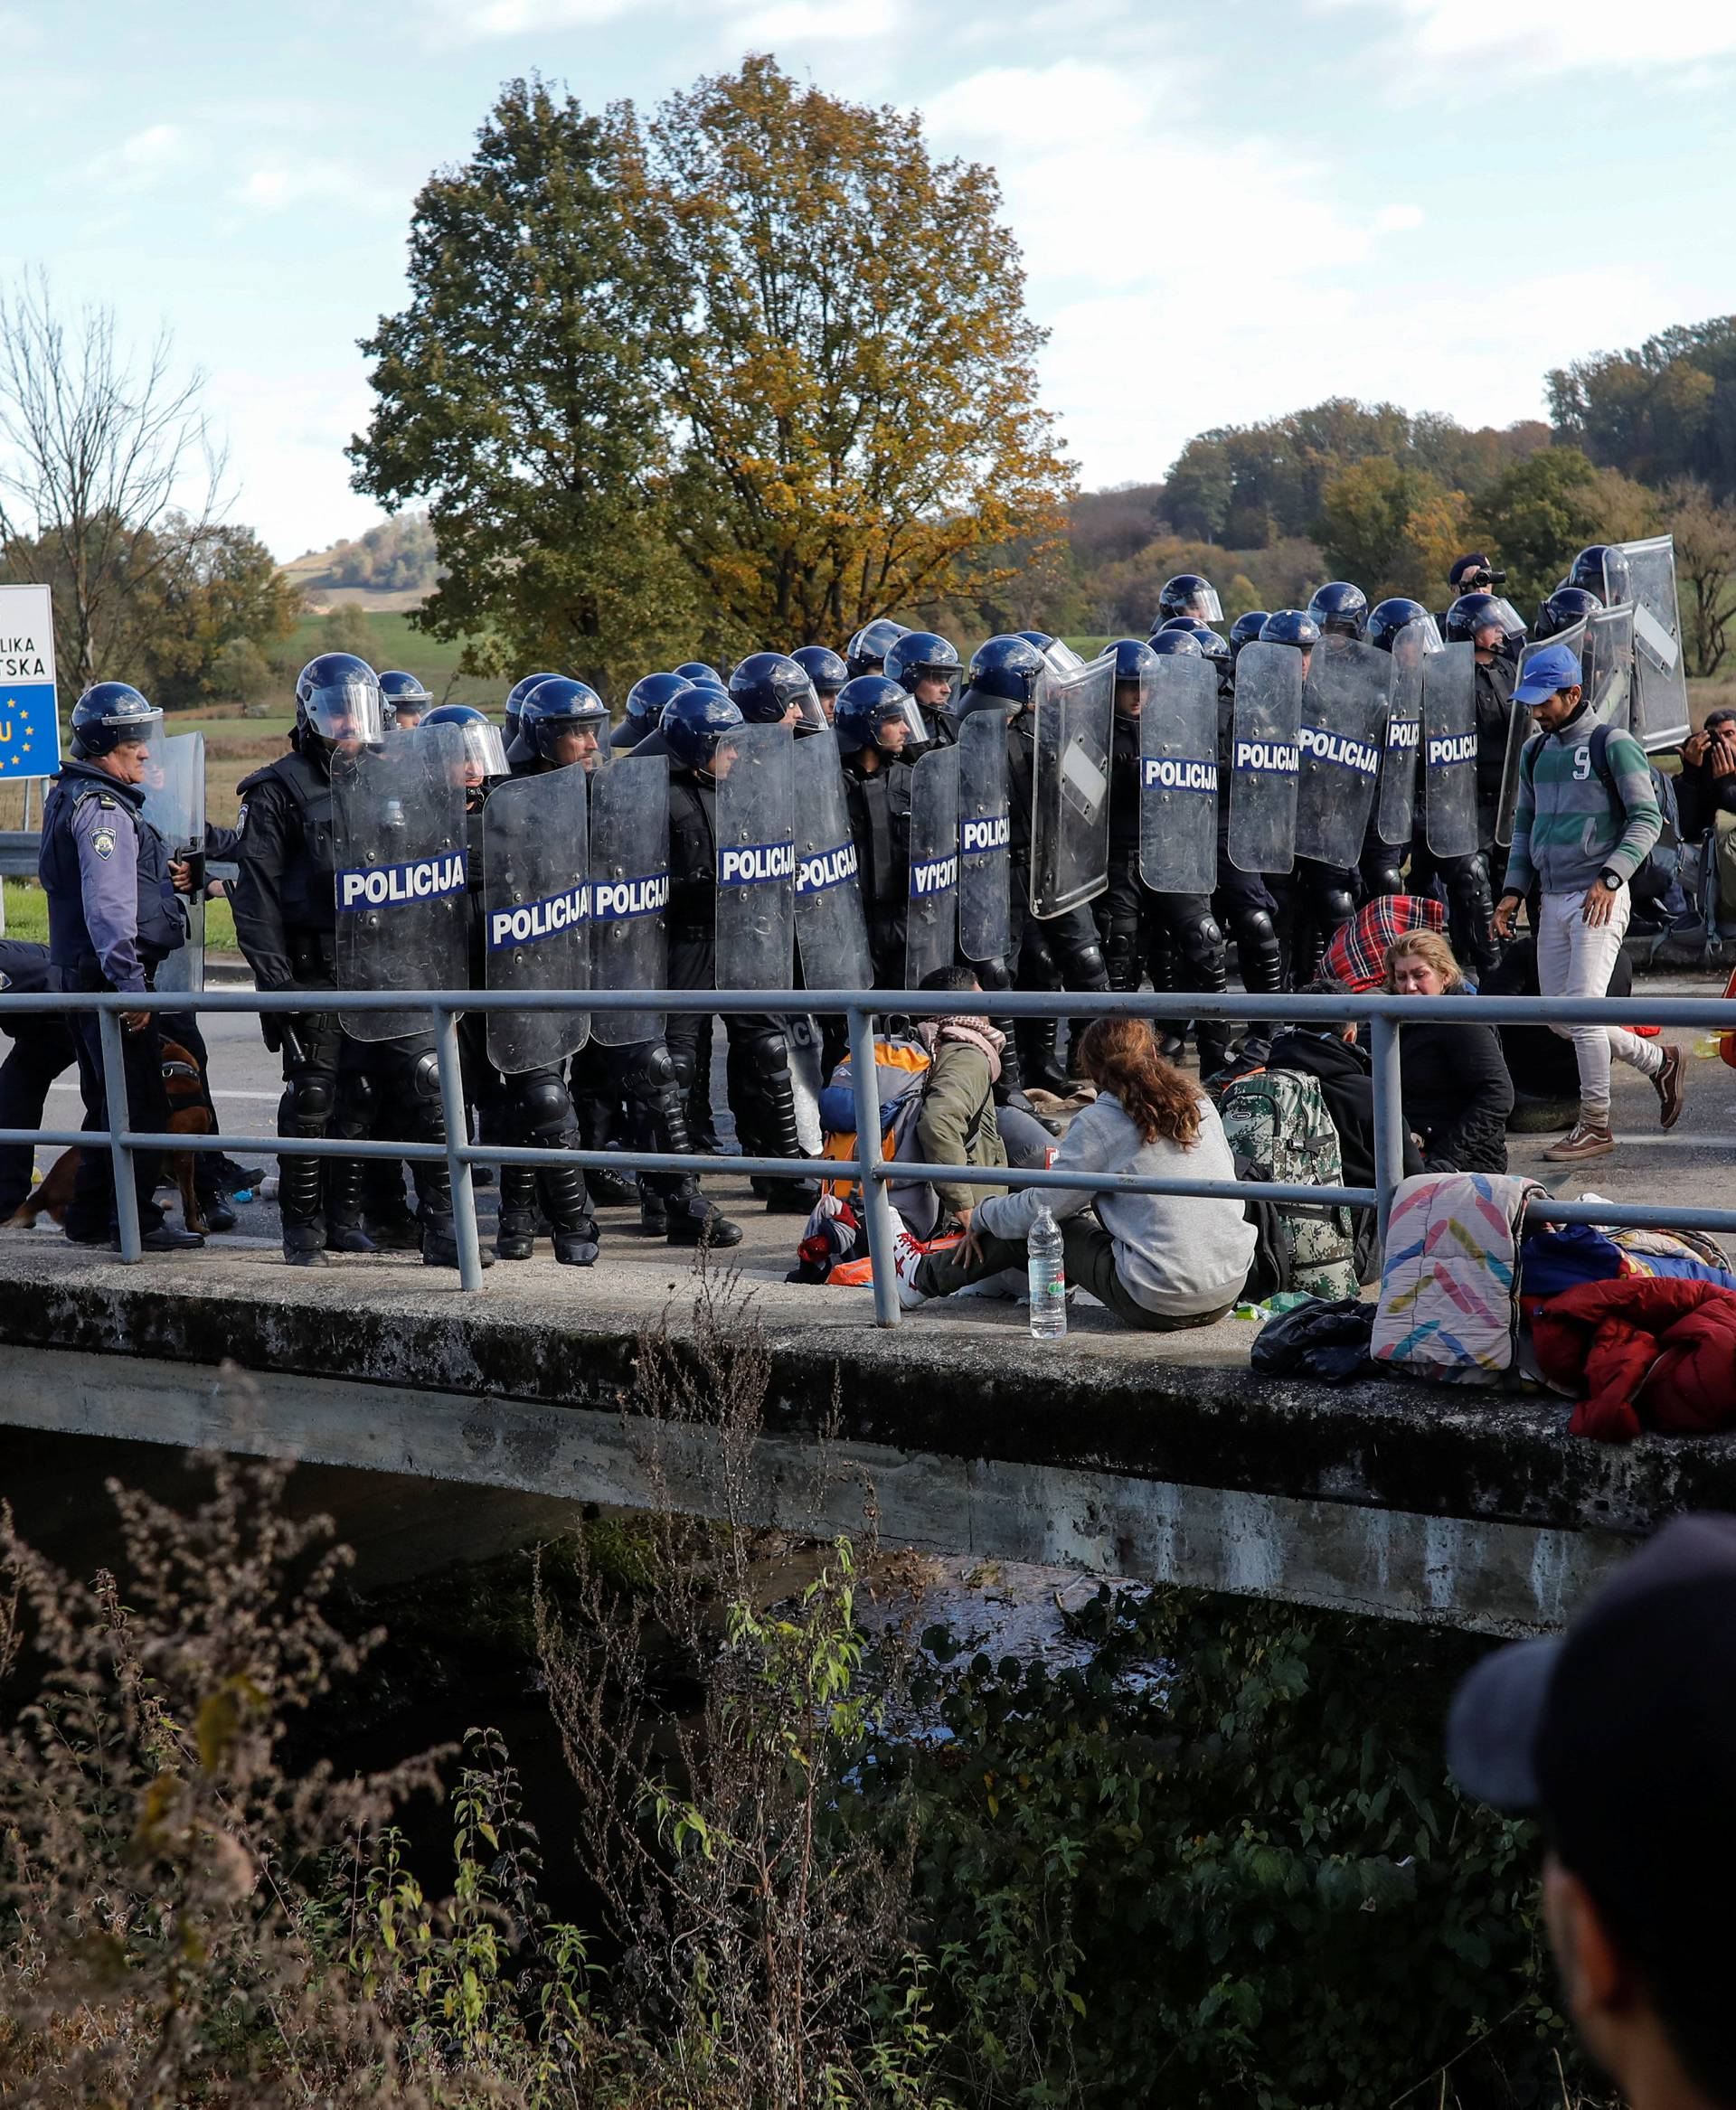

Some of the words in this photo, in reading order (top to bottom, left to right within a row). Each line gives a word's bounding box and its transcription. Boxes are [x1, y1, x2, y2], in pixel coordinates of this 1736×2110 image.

[1238, 743, 1300, 772] POLICIJA
[1299, 729, 1379, 775] POLICIJA
[1572, 746, 1591, 780] 9
[1146, 760, 1218, 791] POLICIJA
[343, 855, 465, 906] POLICIJA
[596, 874, 670, 916] POLICIJA
[493, 885, 589, 945] POLICIJA
